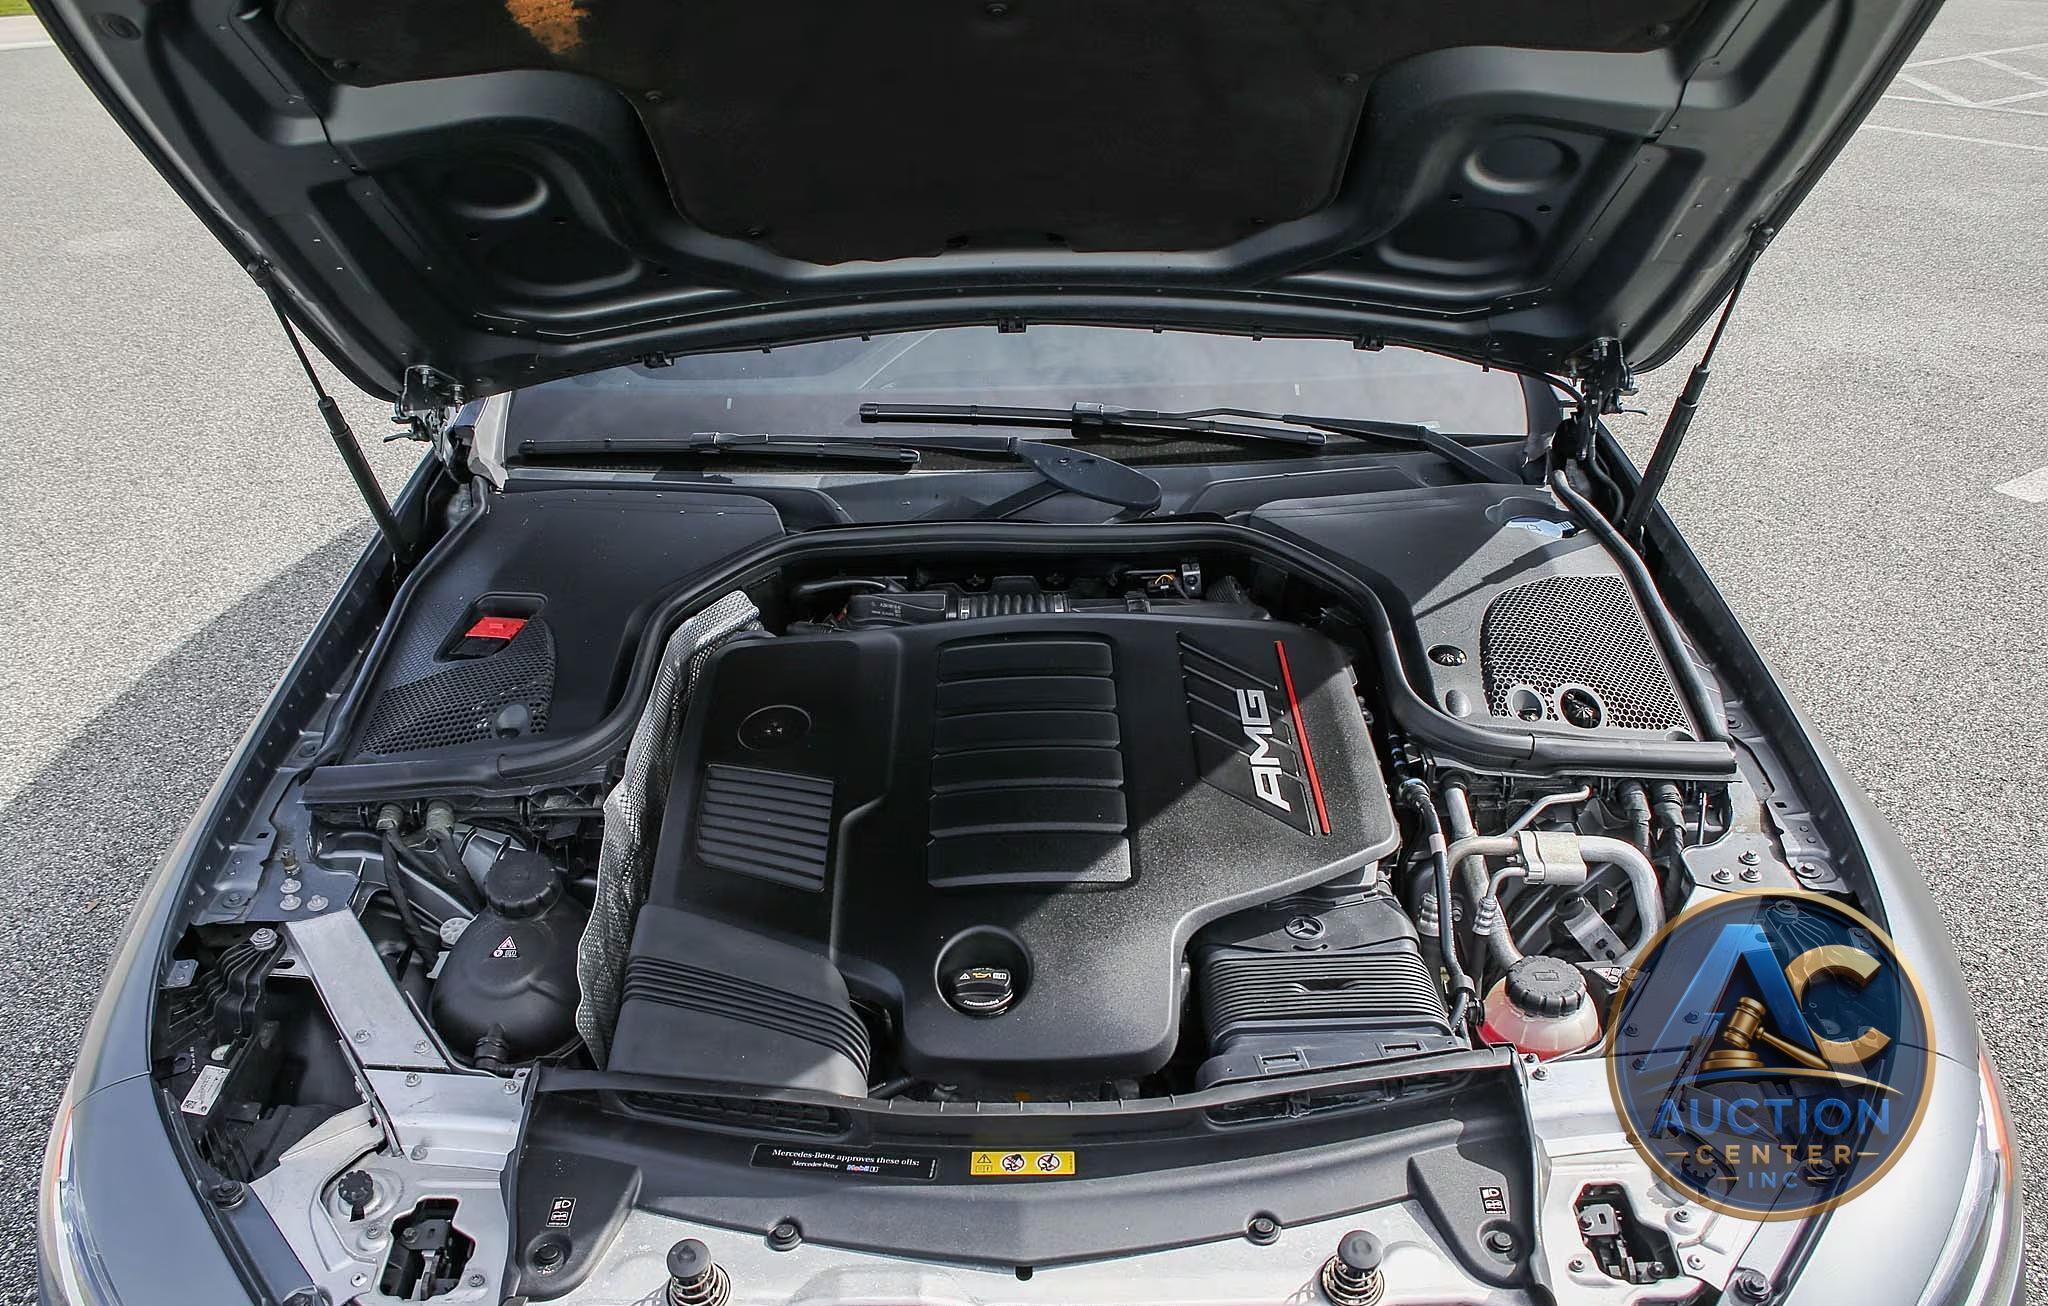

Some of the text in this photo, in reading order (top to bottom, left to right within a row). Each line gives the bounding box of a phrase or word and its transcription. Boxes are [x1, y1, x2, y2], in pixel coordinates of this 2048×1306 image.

[1236, 688, 1292, 813] AMG
[772, 1149, 920, 1166] Mercedes-Benz approves these oils:
[792, 1160, 839, 1169] Mercedes-Benz
